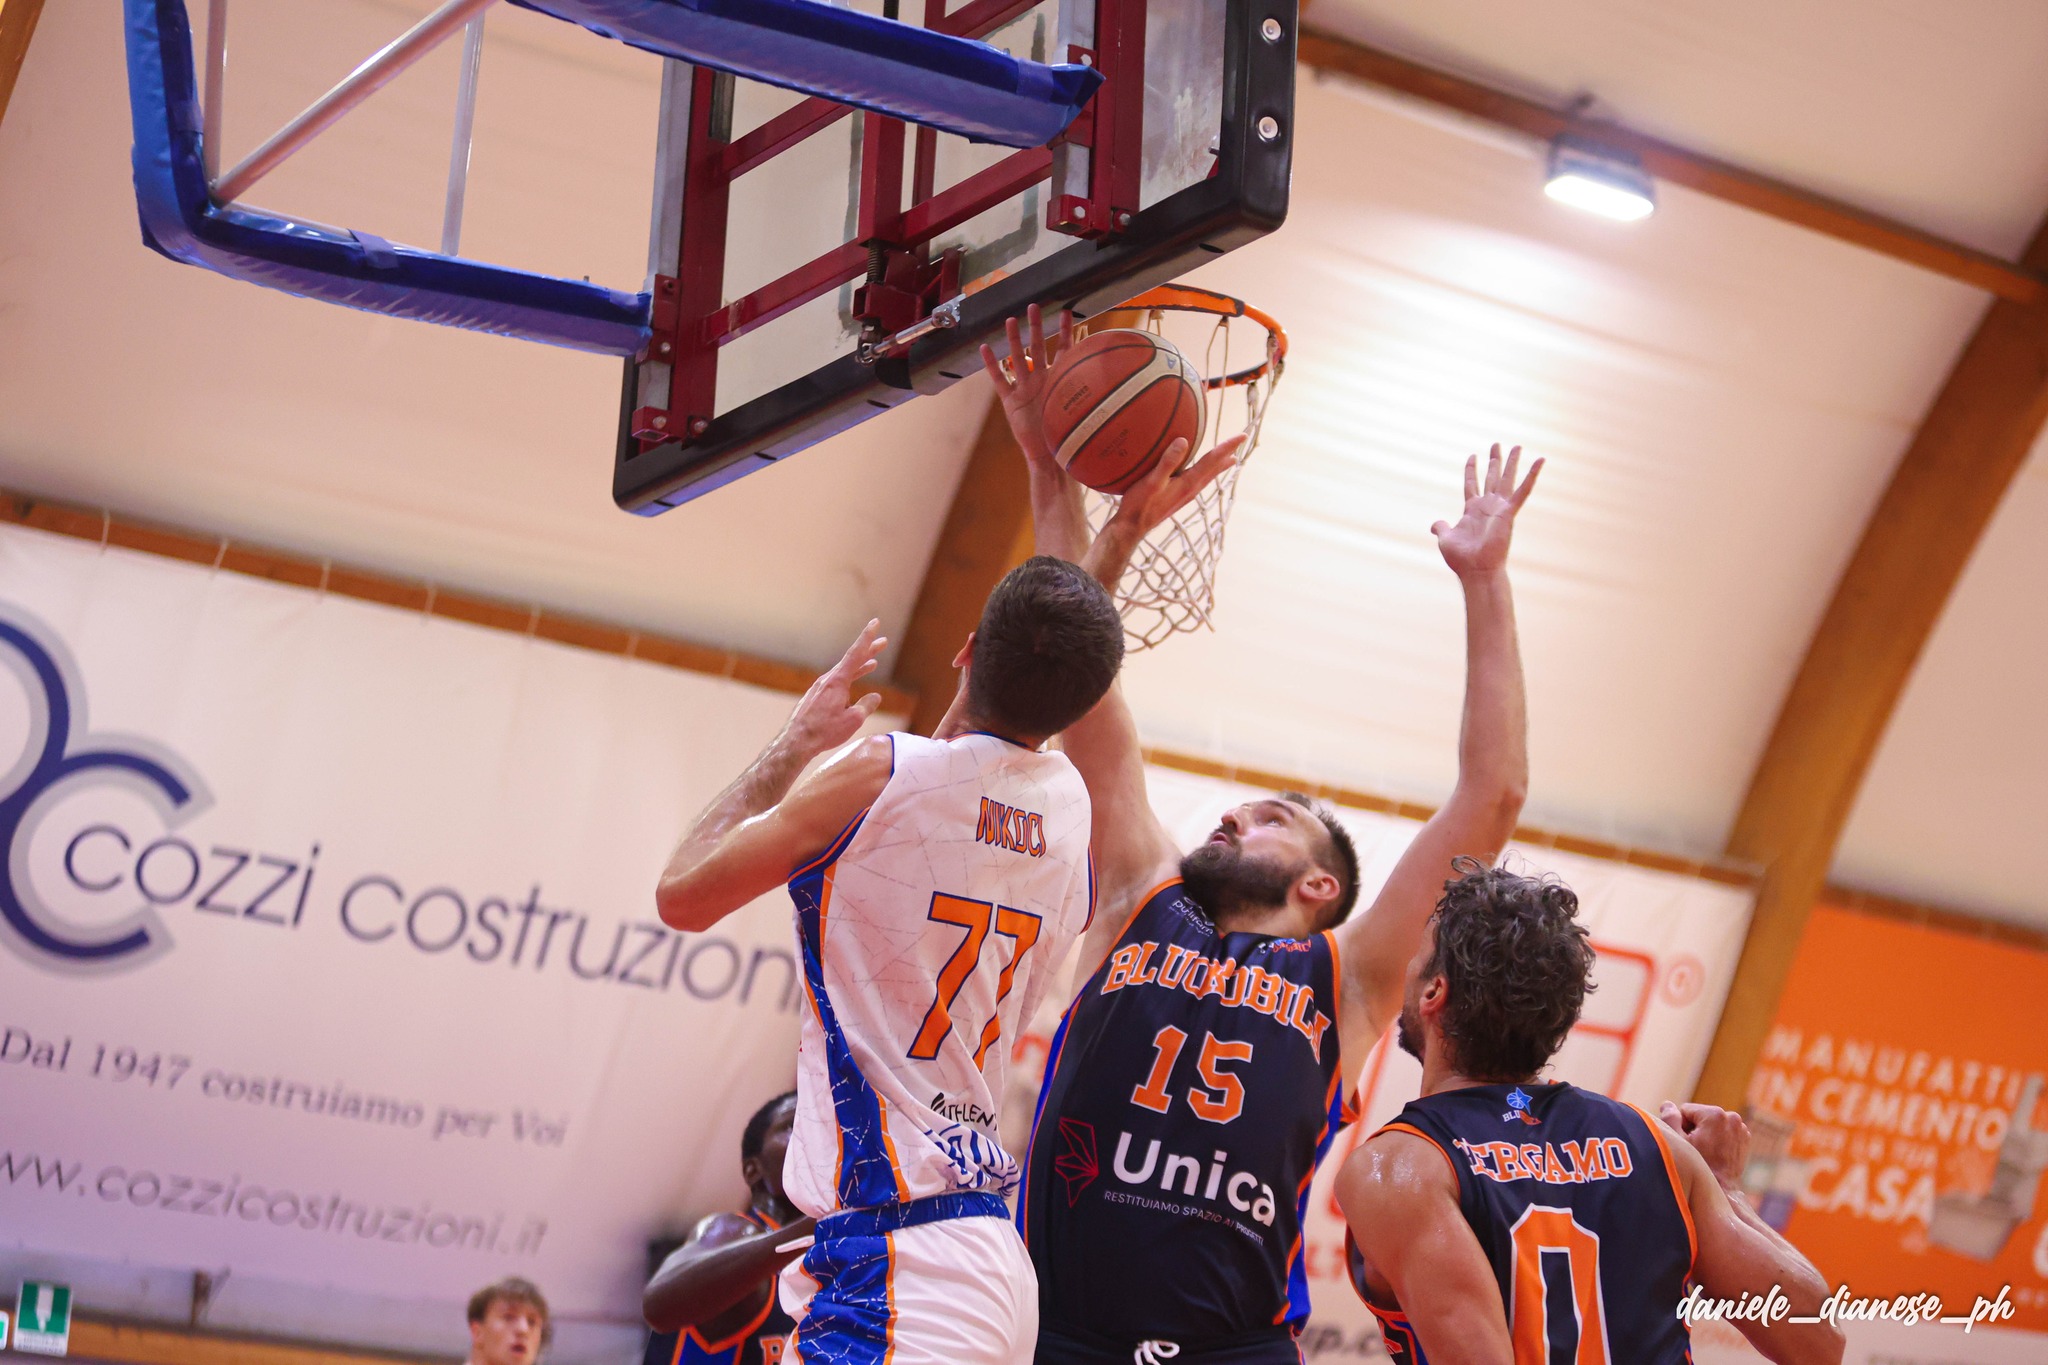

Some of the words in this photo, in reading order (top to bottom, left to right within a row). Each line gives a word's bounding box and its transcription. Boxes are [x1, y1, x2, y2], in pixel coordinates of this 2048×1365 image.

[906, 891, 1042, 1073] 77
[1, 1026, 72, 1072] Dal
[89, 1042, 193, 1090] 1947
[202, 1068, 425, 1128] costruiamo
[430, 1102, 496, 1142] per
[509, 1107, 569, 1149] Voi
[1130, 1024, 1253, 1125] 15
[1767, 1030, 2023, 1110] MANUFATTI
[1811, 1075, 2010, 1151] CEMENTO
[1104, 1190, 1180, 1215] RESTITUIAMO
[1182, 1206, 1222, 1224] SPAZIO
[1113, 1131, 1276, 1228] Unica
[1802, 1156, 1939, 1227] CASA
[1510, 1203, 1613, 1365] 0
